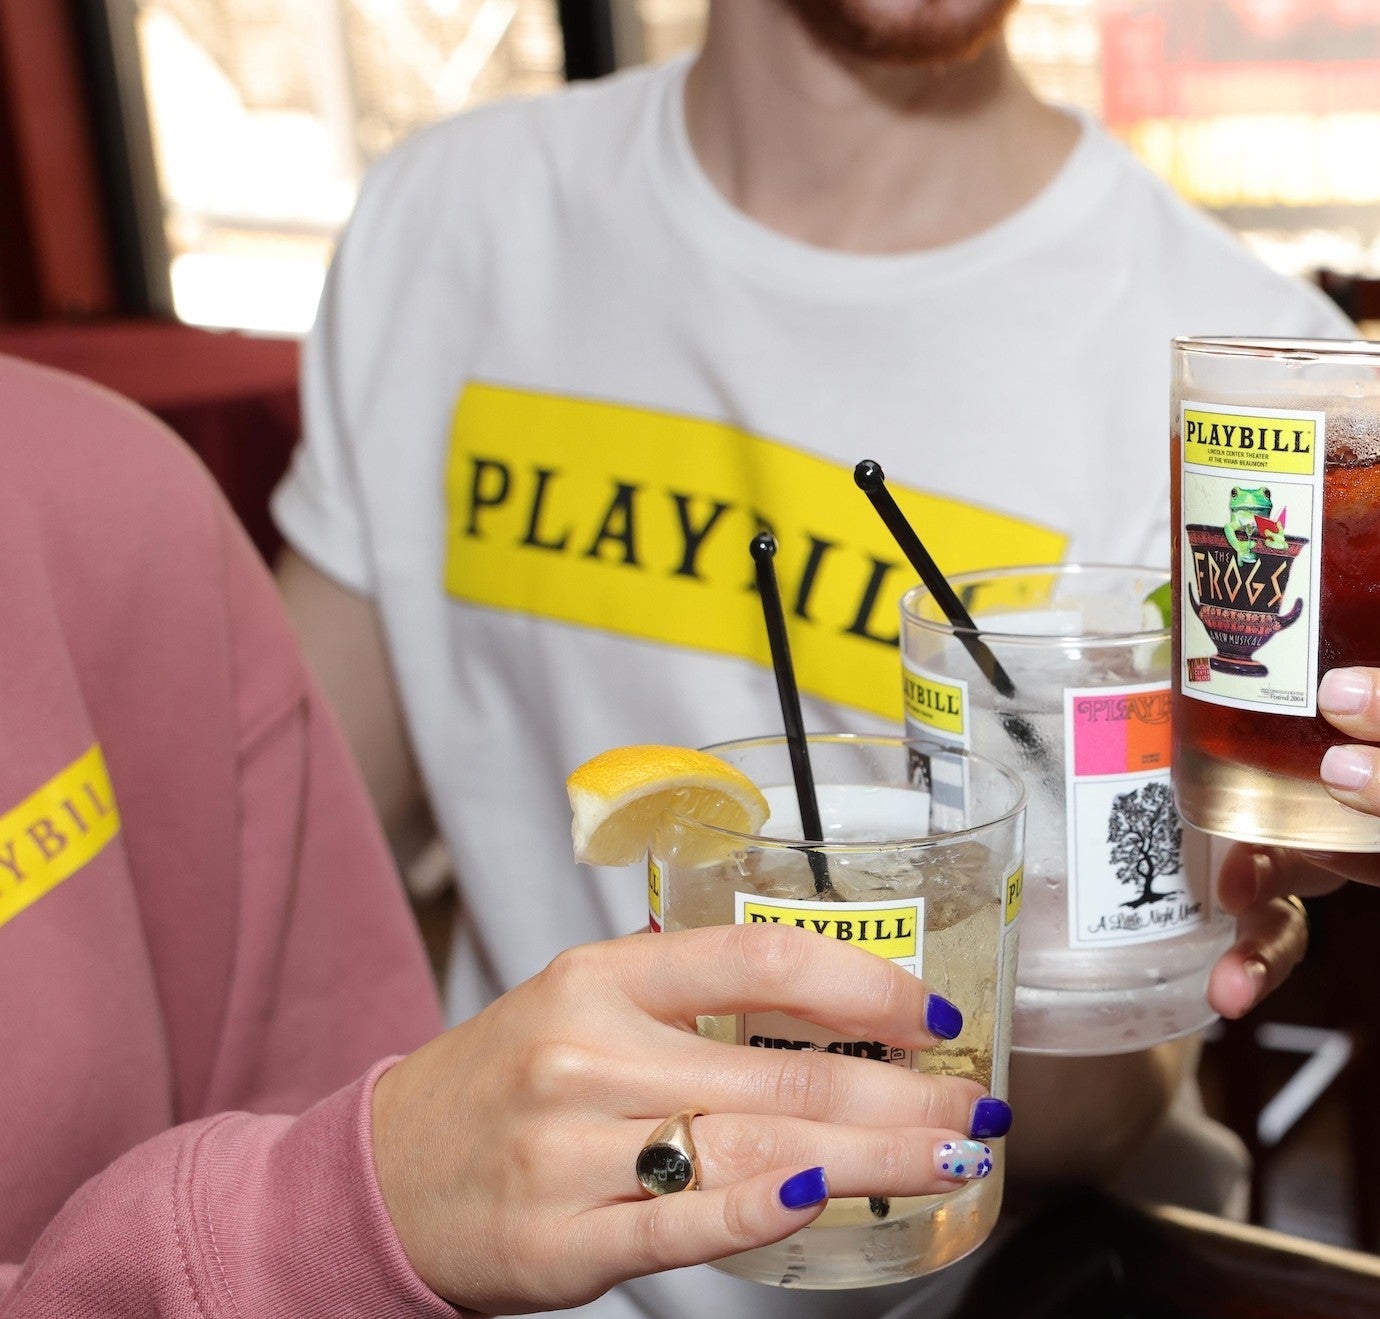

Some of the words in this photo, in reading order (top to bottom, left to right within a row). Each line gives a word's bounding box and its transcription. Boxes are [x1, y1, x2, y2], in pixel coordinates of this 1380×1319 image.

[1186, 420, 1310, 453] PLAYBILL
[1207, 448, 1226, 456] LINCOLN
[1226, 450, 1245, 458] CENTER
[1246, 452, 1270, 460] THEATER
[1239, 459, 1269, 468] BEAUMONT
[463, 455, 994, 647] PLAYIL
[1214, 550, 1230, 563] THE
[1194, 550, 1288, 608] FROGS
[1228, 634, 1262, 646] MUSICAL
[1077, 693, 1172, 725] PLAYB
